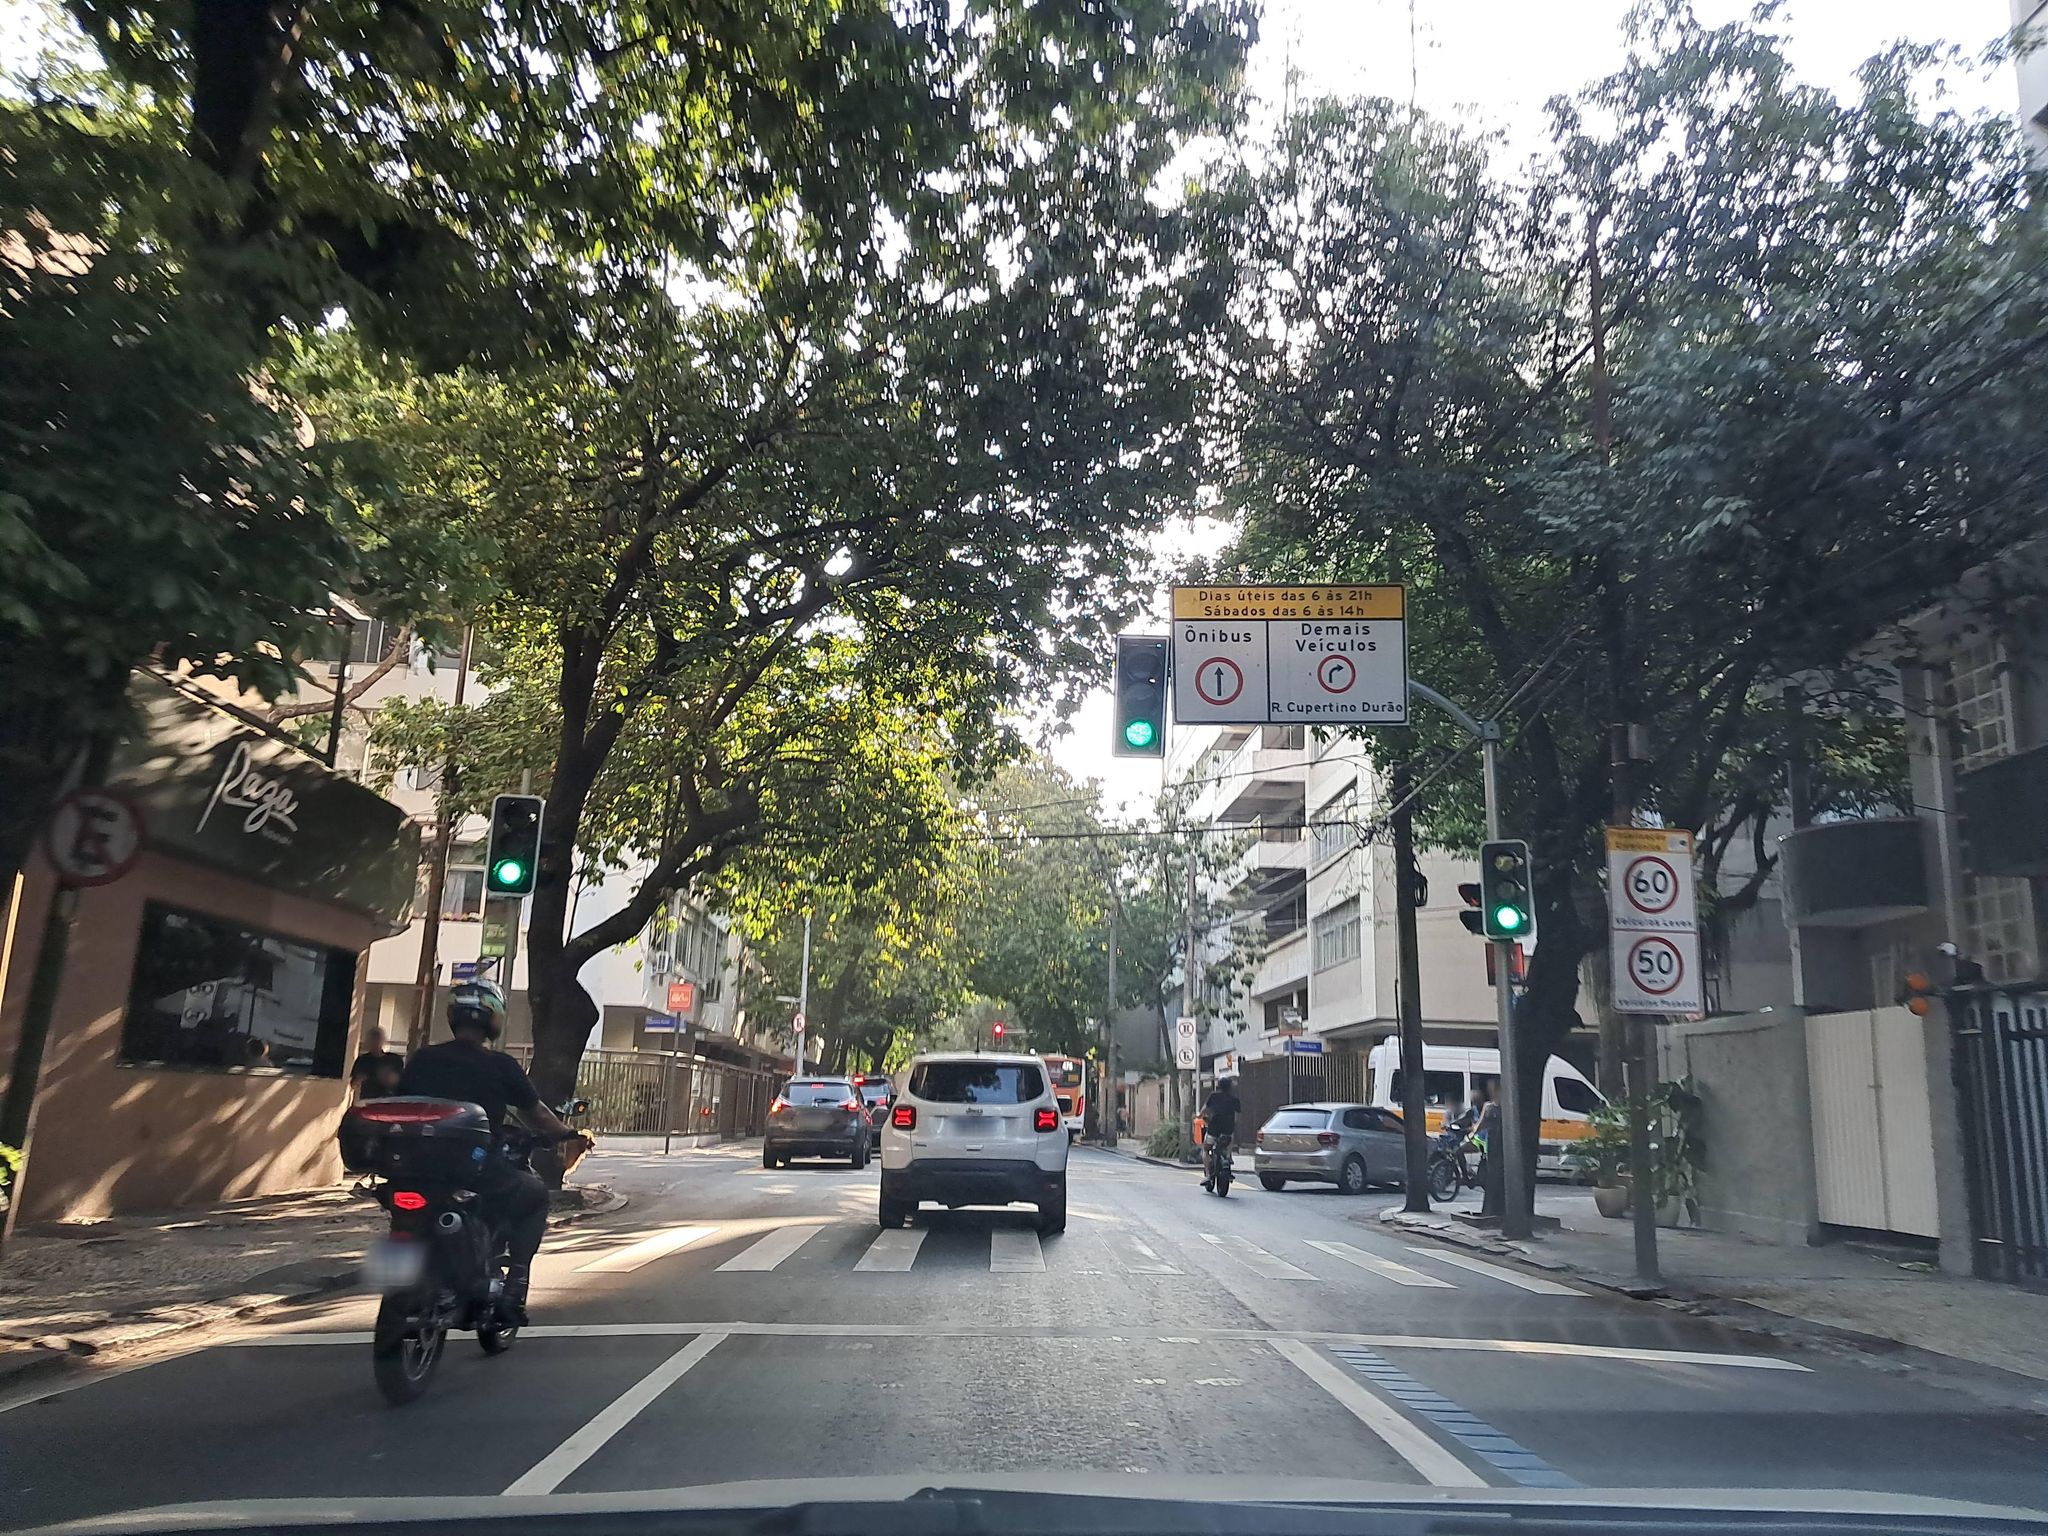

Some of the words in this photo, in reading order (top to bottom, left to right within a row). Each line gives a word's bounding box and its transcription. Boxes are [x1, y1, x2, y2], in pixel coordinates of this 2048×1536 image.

[1199, 590, 1231, 601] Dias
[1238, 590, 1275, 601] úteis
[1281, 590, 1305, 601] das
[1312, 590, 1321, 601] 6
[1349, 590, 1373, 601] 21h
[1204, 605, 1266, 616] Sábados
[1272, 605, 1297, 616] das
[1303, 605, 1311, 616] 6
[1340, 605, 1364, 616] 14h
[1185, 624, 1252, 643] Ônibus
[1301, 622, 1371, 636] Demais
[1295, 638, 1377, 652] Veículos
[1271, 702, 1283, 712] R.
[1286, 701, 1357, 715] Cupertino
[1362, 701, 1403, 713] Durão
[1633, 869, 1668, 894] 60
[1638, 949, 1674, 975] 50
